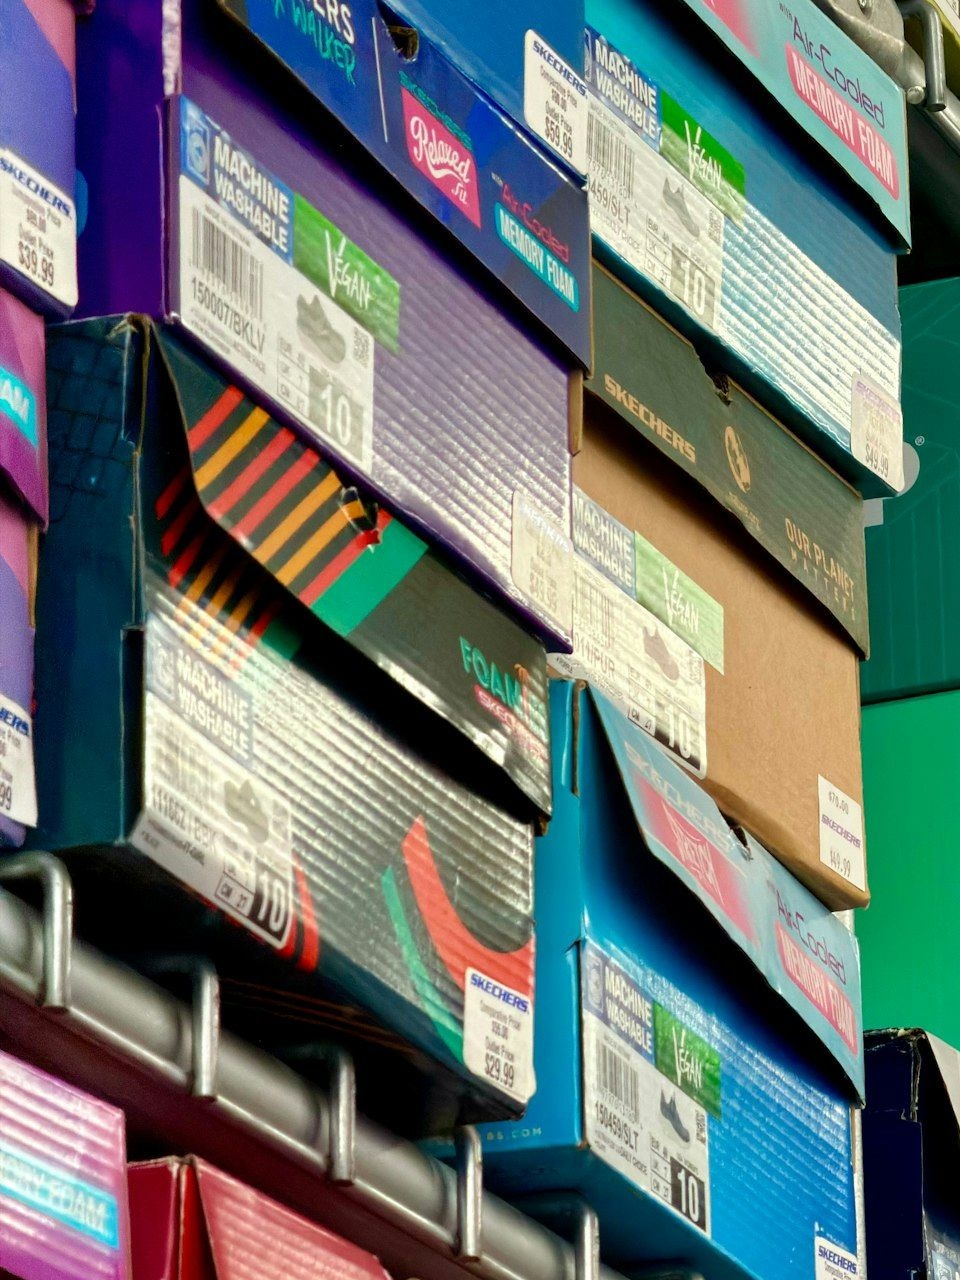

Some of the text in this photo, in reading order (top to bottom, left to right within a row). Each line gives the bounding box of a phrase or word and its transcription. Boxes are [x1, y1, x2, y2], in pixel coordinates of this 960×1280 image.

[533, 39, 587, 97] SKECHERS
[594, 37, 658, 109] MACHINE
[596, 66, 659, 139] WASHABLE
[793, 17, 885, 128] Air-Cooled
[410, 116, 471, 184] Relaxed
[792, 51, 896, 190] MEMORY FOAM
[213, 171, 289, 255] WASHABLE
[214, 133, 290, 223] MACHINE
[499, 207, 576, 303] MEMORY FOAM
[502, 182, 571, 262] Air-Cooled
[324, 229, 373, 309] VEGAN
[683, 262, 706, 316] 10
[322, 379, 352, 437] 10
[604, 372, 697, 464] SKECHERS
[573, 496, 633, 568] MACHINE
[177, 649, 252, 731] MACHINE
[821, 813, 862, 849] SKECHERS
[258, 866, 288, 931] 10
[776, 888, 847, 986] Air-Cooled
[470, 974, 529, 1015] SKECHERS
[604, 964, 653, 1028] MACHINE
[485, 1053, 515, 1089] $29.99
